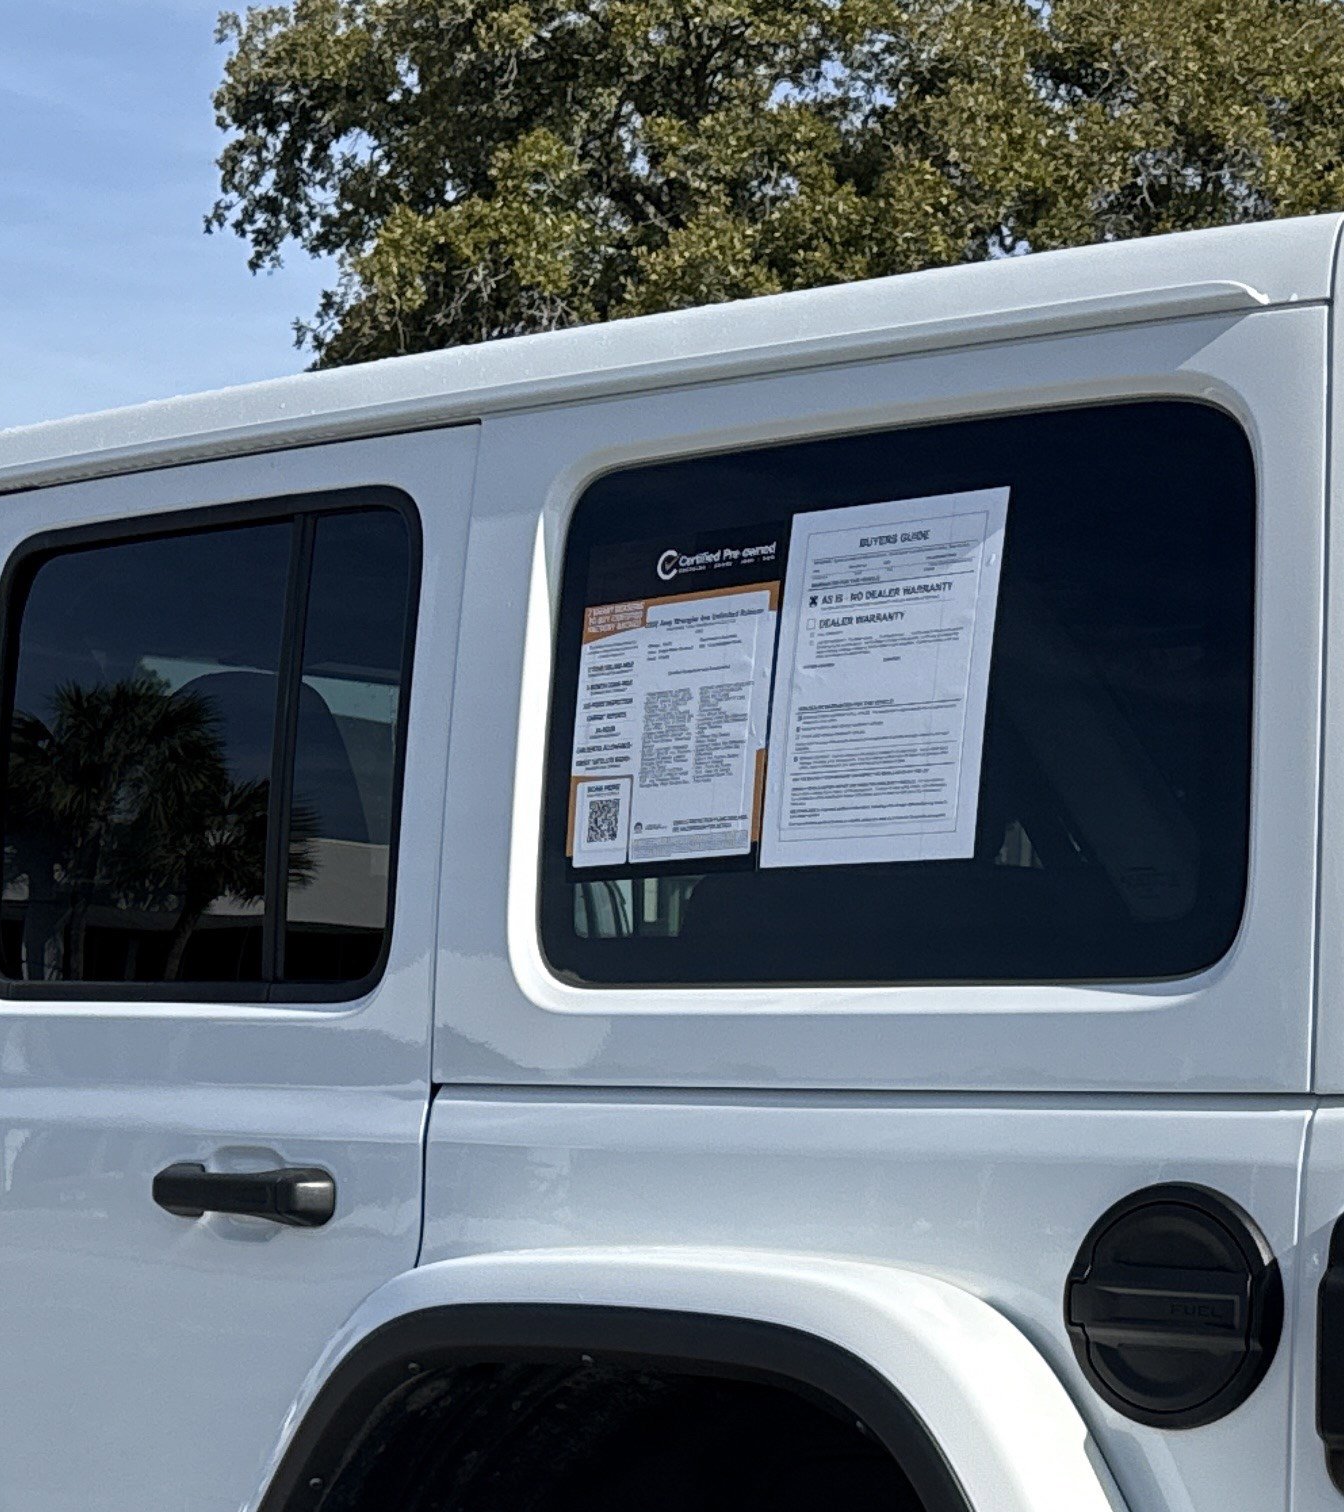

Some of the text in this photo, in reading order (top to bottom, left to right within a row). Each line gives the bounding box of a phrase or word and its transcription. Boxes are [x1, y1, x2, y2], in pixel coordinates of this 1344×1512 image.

[859, 529, 931, 548] BUYERS GUIDE
[678, 550, 722, 567] Certified
[821, 595, 834, 605] AS
[835, 593, 844, 604] IS
[850, 591, 863, 602] NO
[865, 588, 901, 600] DEALER
[903, 582, 954, 597] WARRANTY
[819, 611, 906, 630] DEALER WARRANTY
[1169, 1302, 1223, 1320] FUEL
